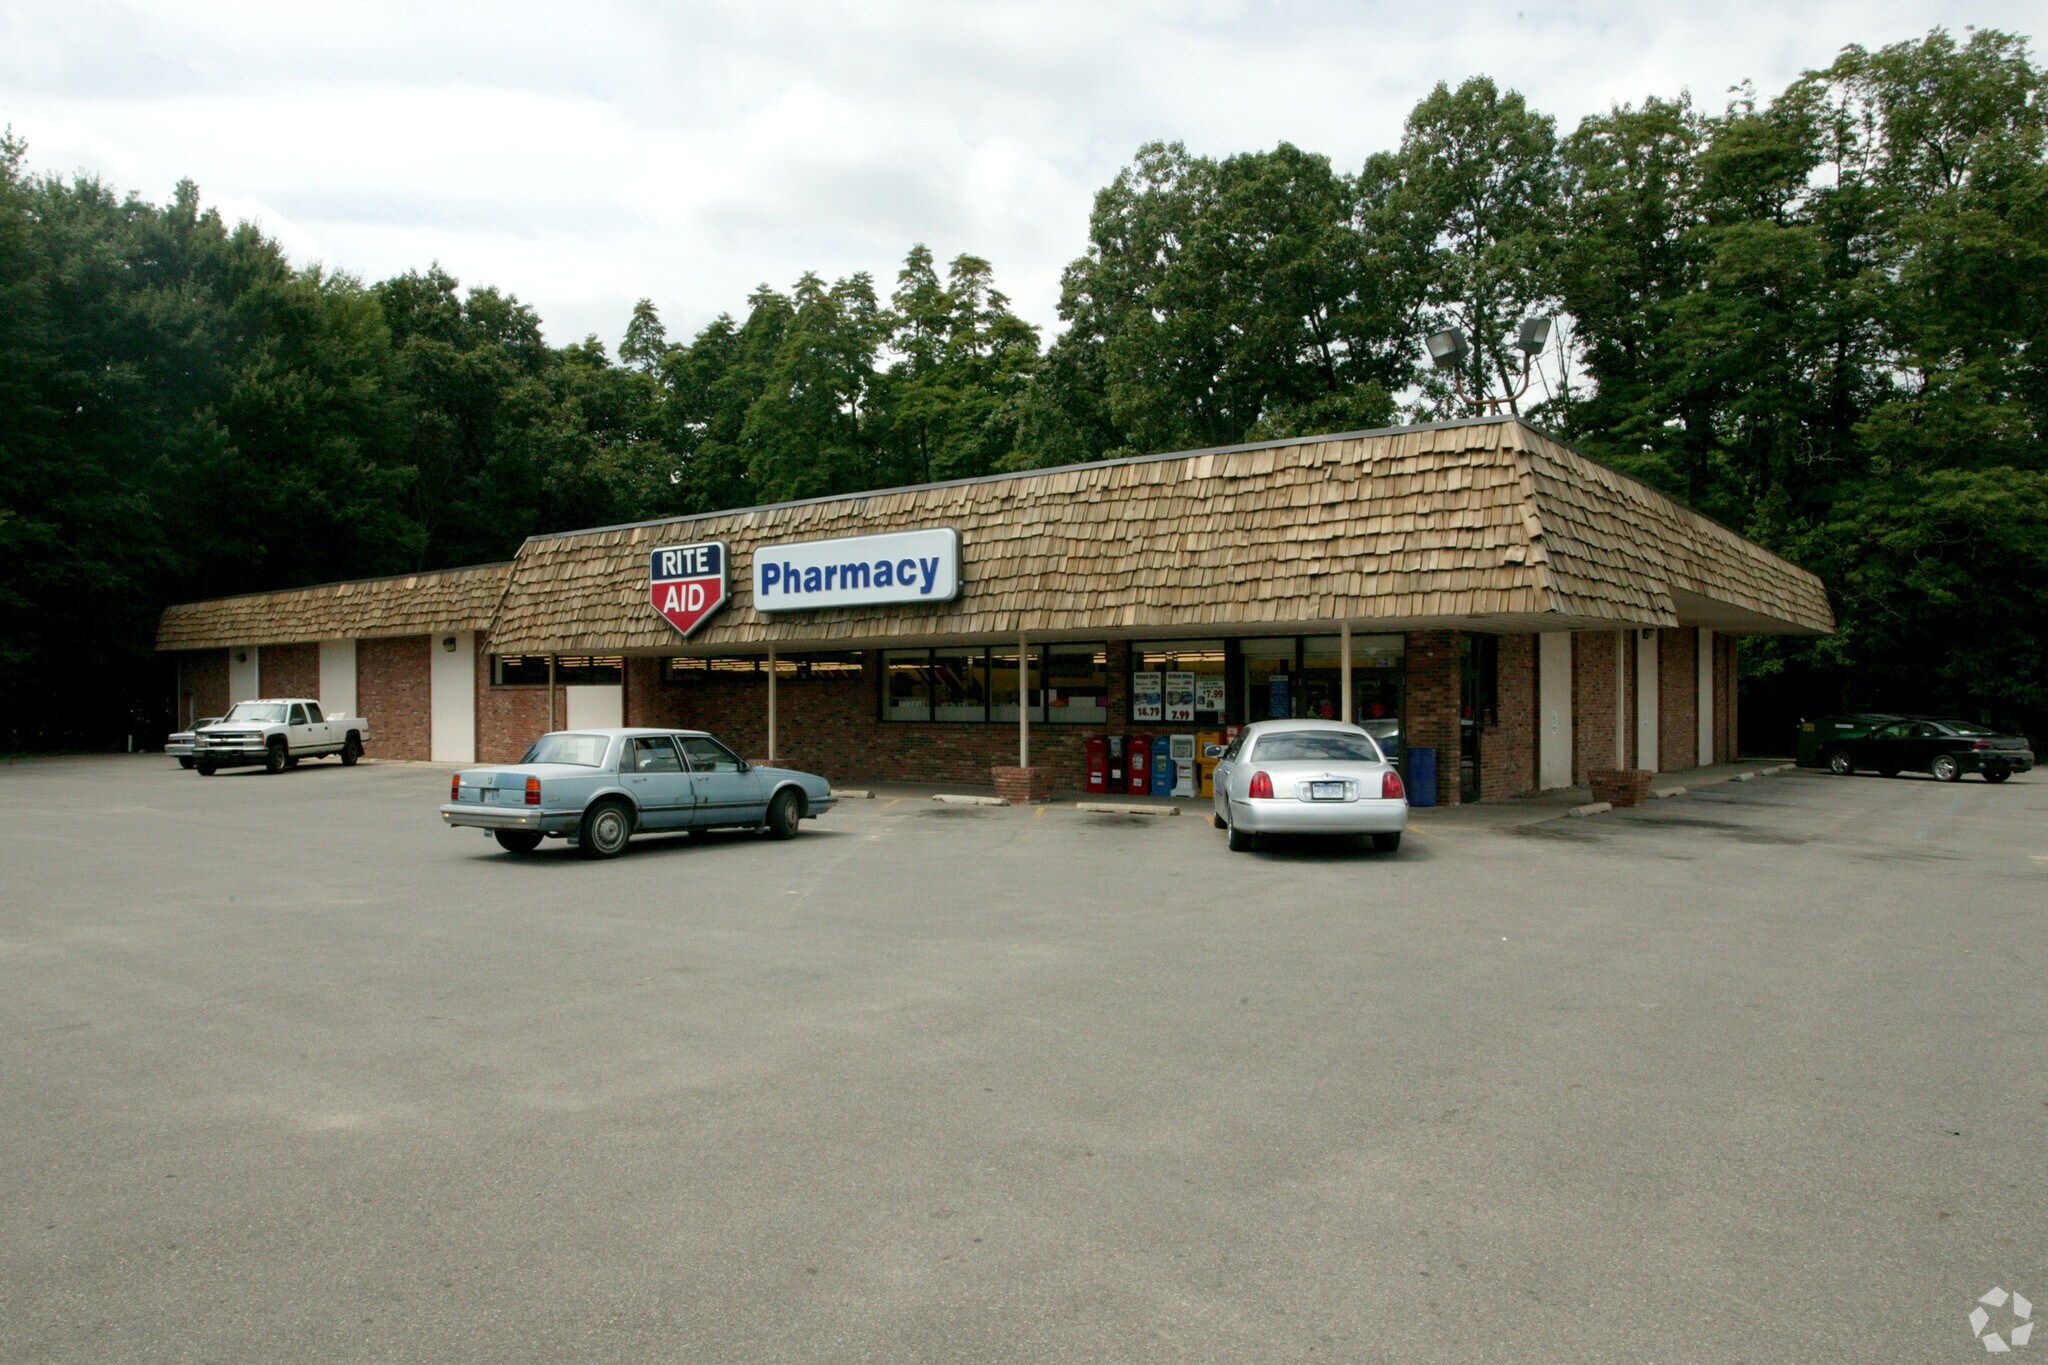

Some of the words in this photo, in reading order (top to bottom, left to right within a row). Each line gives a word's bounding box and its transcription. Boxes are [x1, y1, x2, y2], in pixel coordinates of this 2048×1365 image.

[661, 547, 710, 576] RITE
[760, 556, 941, 596] Pharmacy
[663, 582, 706, 614] AID
[1171, 710, 1190, 720] 7.99
